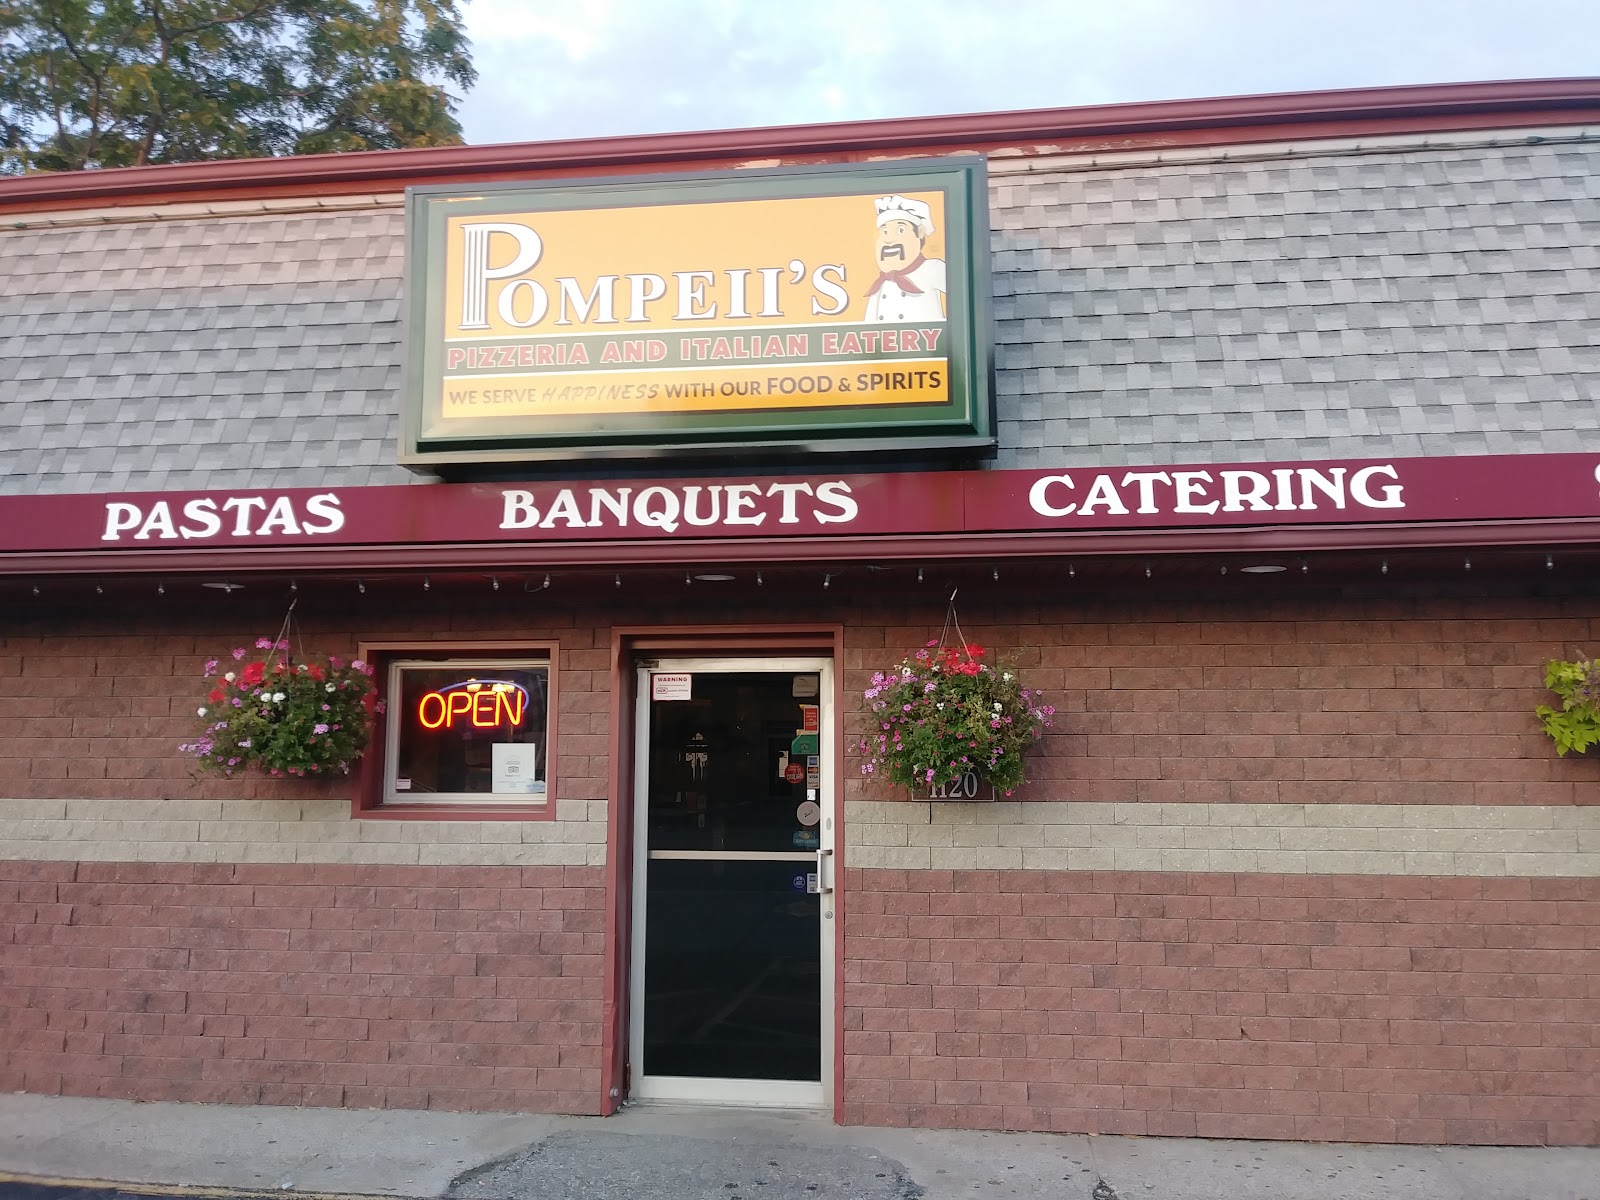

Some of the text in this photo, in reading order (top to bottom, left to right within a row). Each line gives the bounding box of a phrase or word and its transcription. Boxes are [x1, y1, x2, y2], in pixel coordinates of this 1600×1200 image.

[447, 328, 943, 370] PIZZERIA AND ITALIAN EATERY
[449, 370, 942, 405] WE SERVE HAPPINESS WITH OUR FOOD & SPIRITS
[498, 480, 859, 533] BANQUETS
[1028, 464, 1406, 517] CATERING
[101, 492, 345, 541] PASTAS
[418, 689, 523, 729] OPEN
